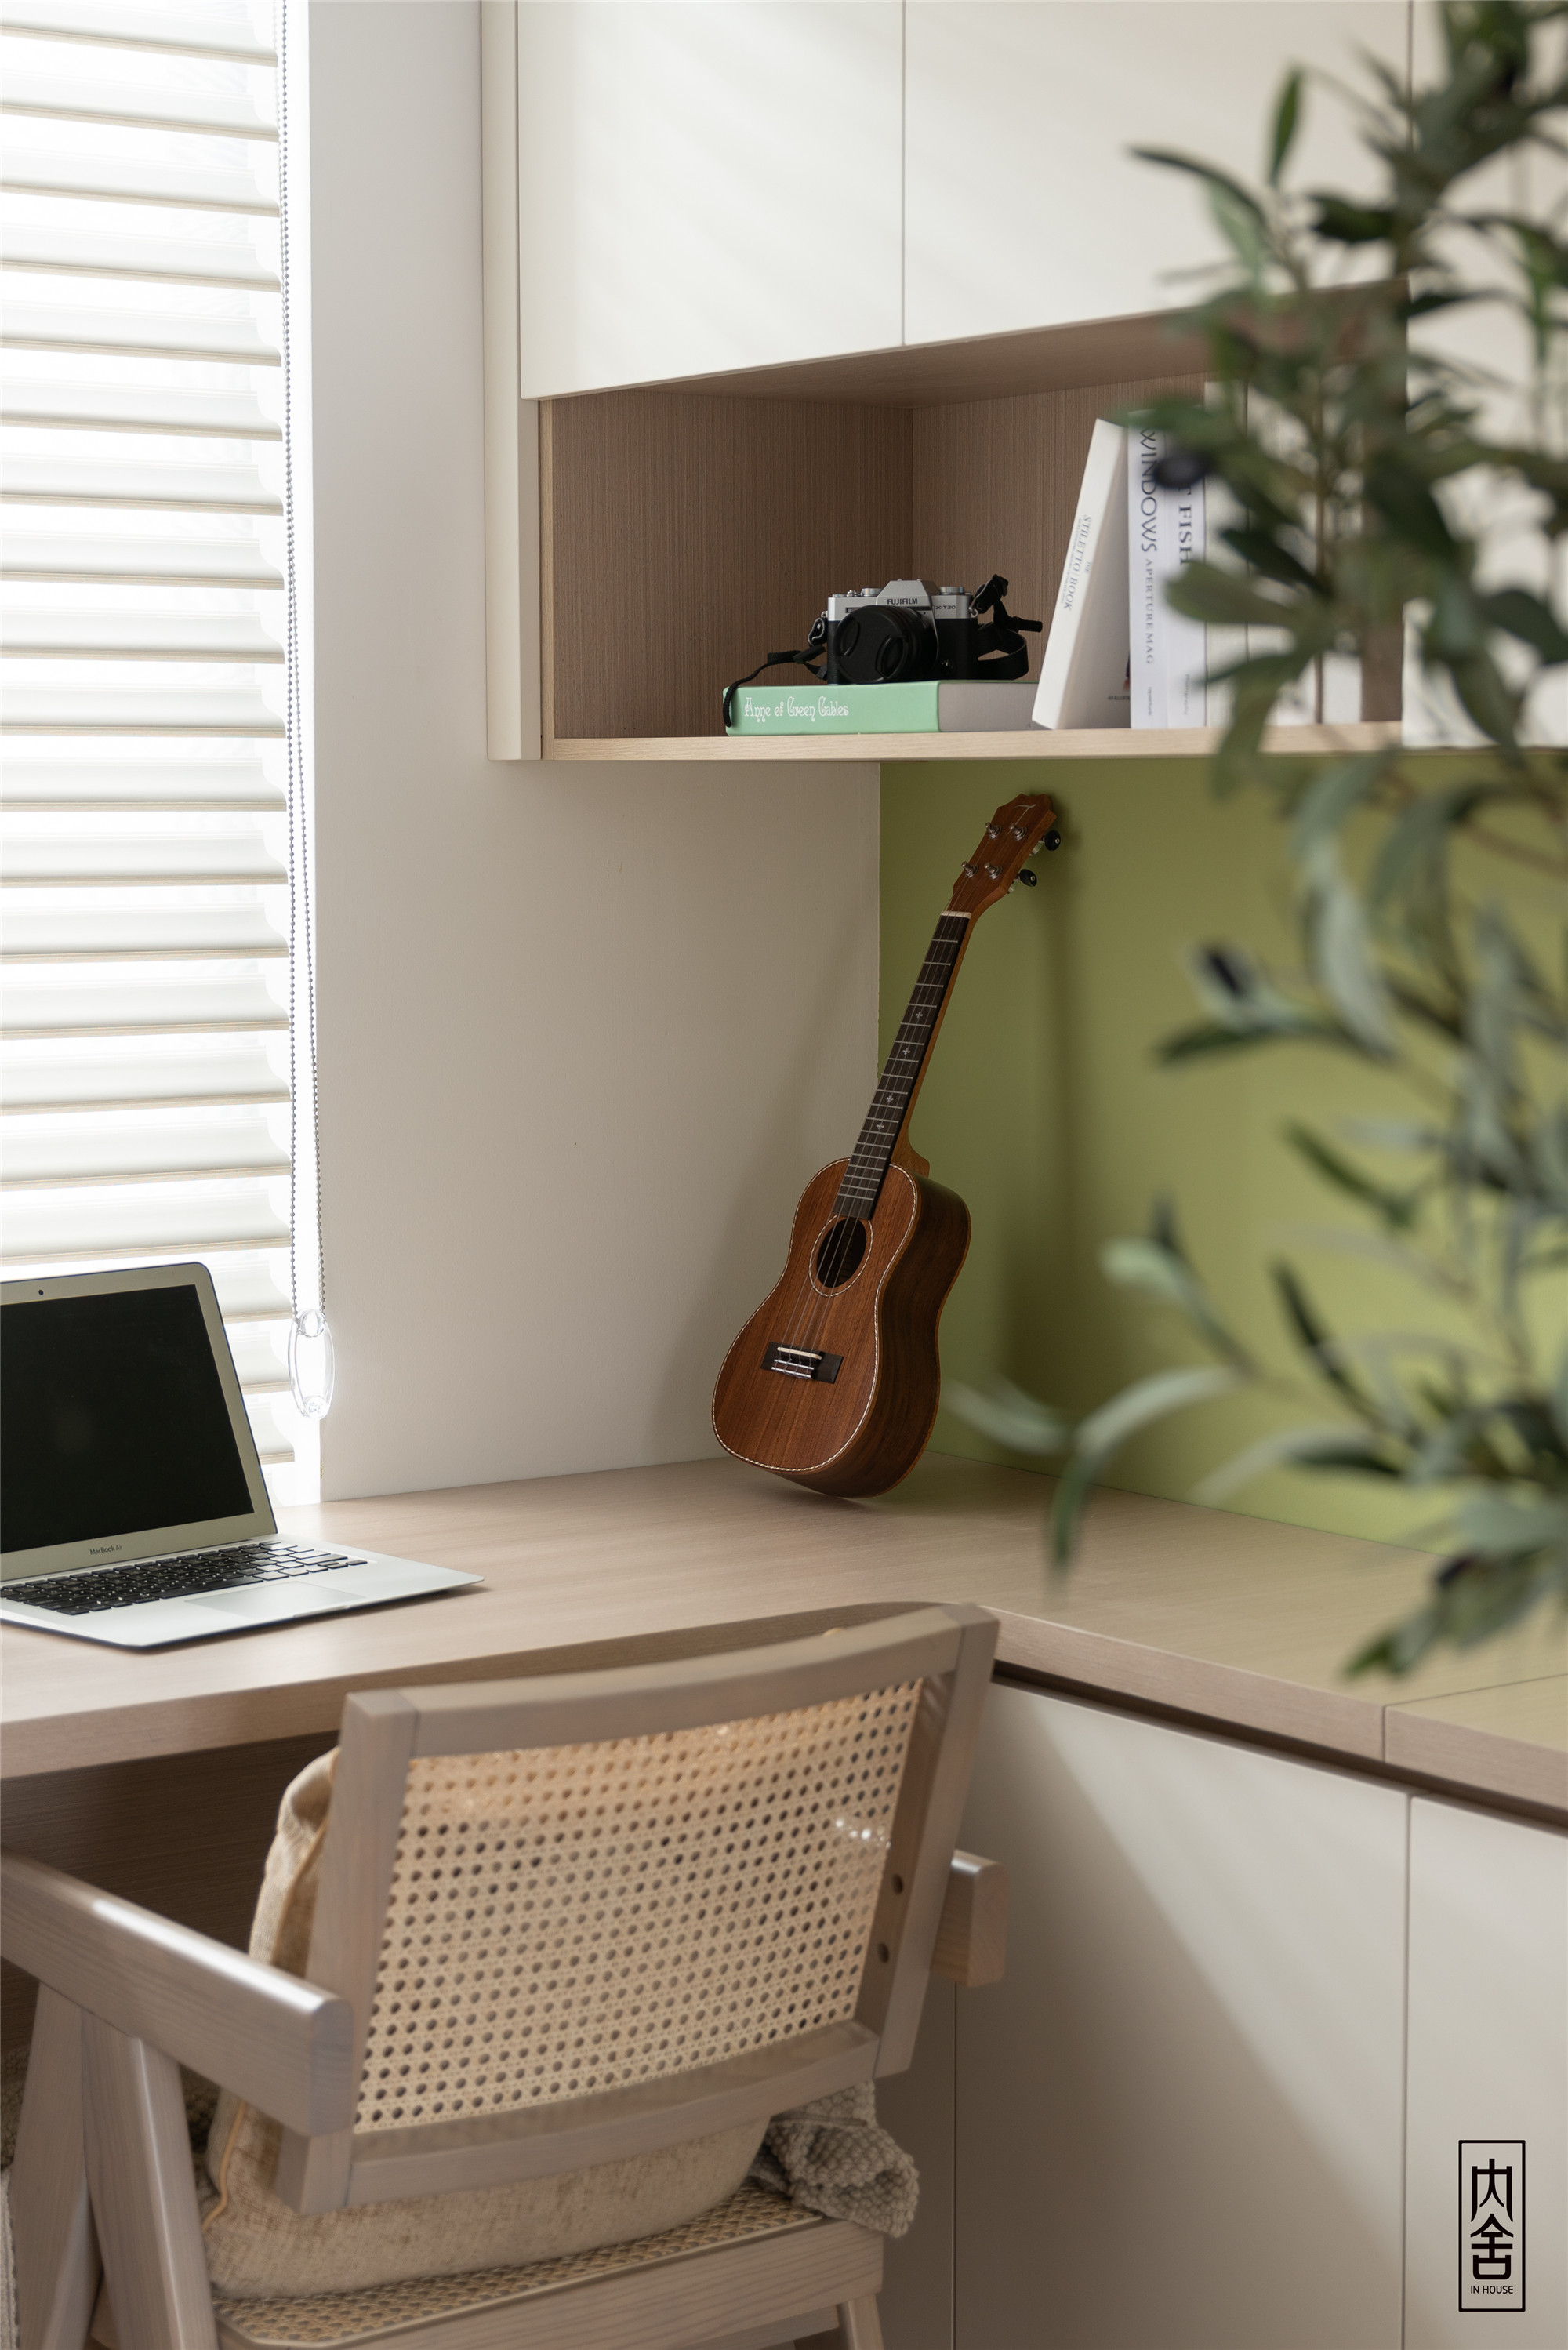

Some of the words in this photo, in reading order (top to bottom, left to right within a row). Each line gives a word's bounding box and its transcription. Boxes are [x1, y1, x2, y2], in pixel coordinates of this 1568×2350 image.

[1139, 427, 1157, 552] WINDOWS
[1073, 514, 1091, 572] STILETTO
[1178, 505, 1192, 565] FISH
[1064, 576, 1078, 611] BOOK
[1145, 558, 1153, 630] APERTURE
[1145, 632, 1154, 665] MAG
[744, 697, 771, 722] Anne
[774, 701, 784, 717] of
[787, 696, 815, 722] Green
[818, 696, 849, 717] Gables
[89, 1545, 115, 1555] MacBook
